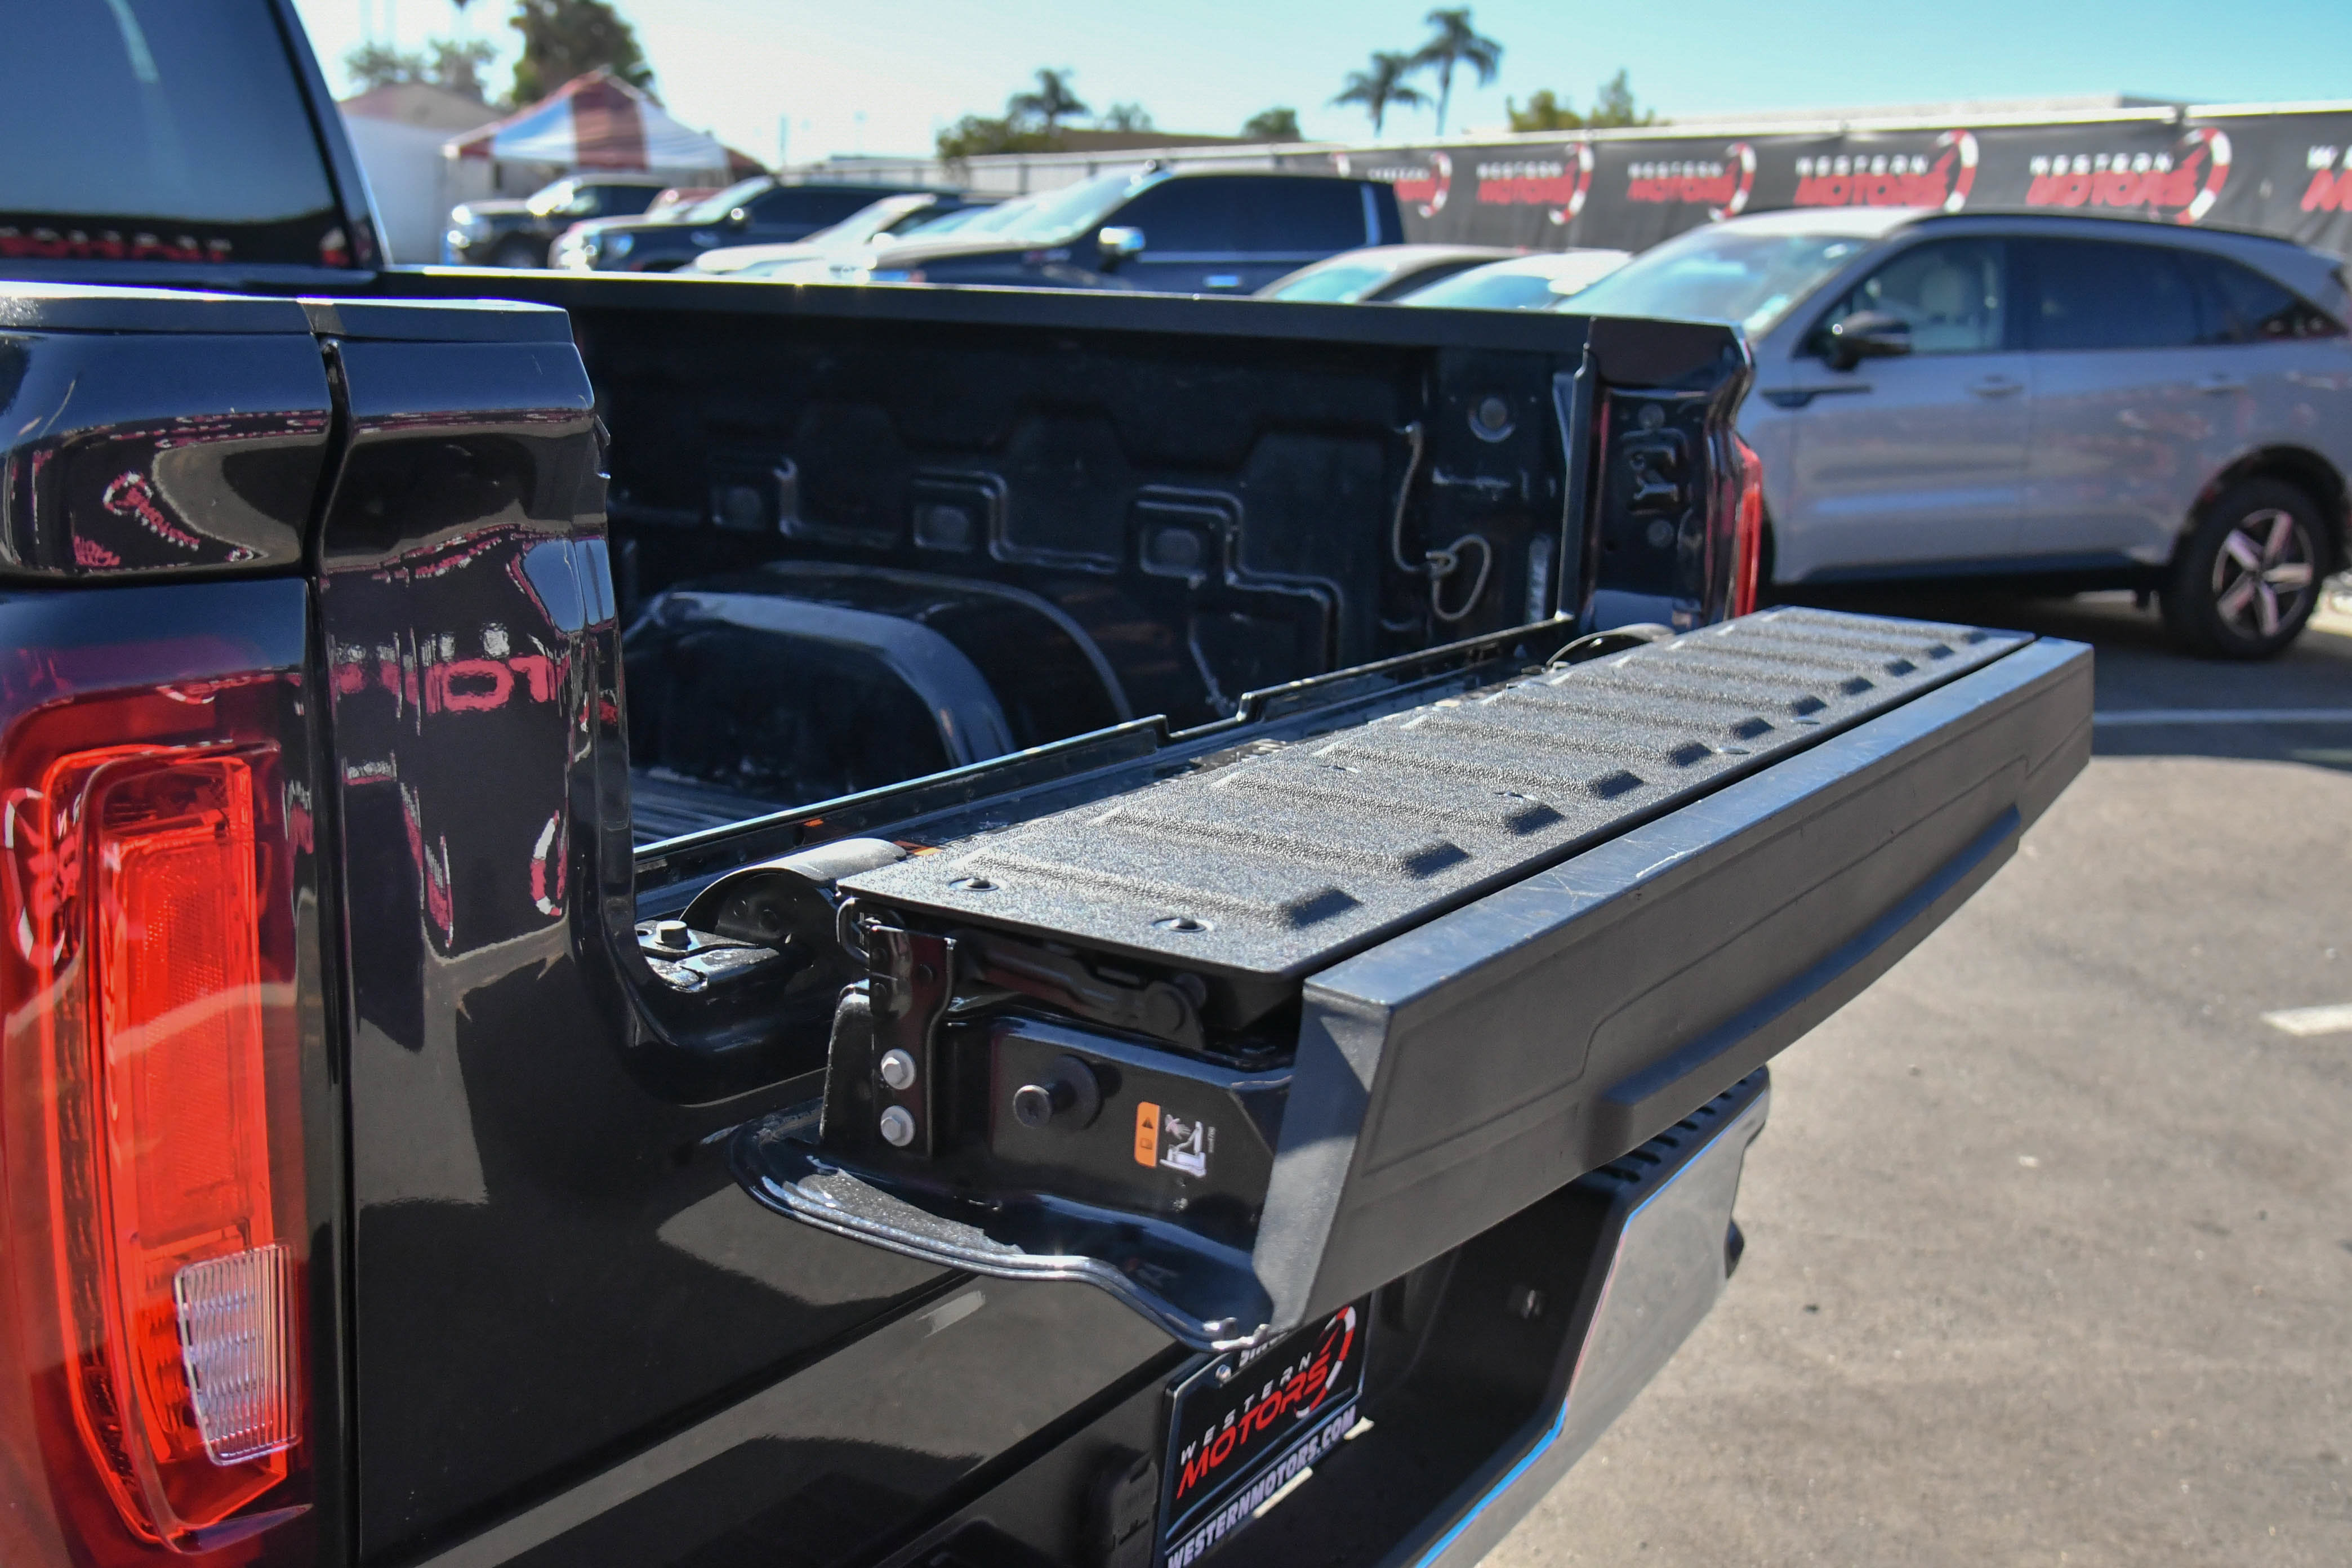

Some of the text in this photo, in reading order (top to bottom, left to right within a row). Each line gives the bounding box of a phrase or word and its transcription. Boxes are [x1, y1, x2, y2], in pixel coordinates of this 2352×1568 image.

[1177, 1352, 1330, 1499] MOTORS
[1181, 1352, 1312, 1466] WESTERN
[1168, 1405, 1356, 1568] WESTERNMOTORS.COM
